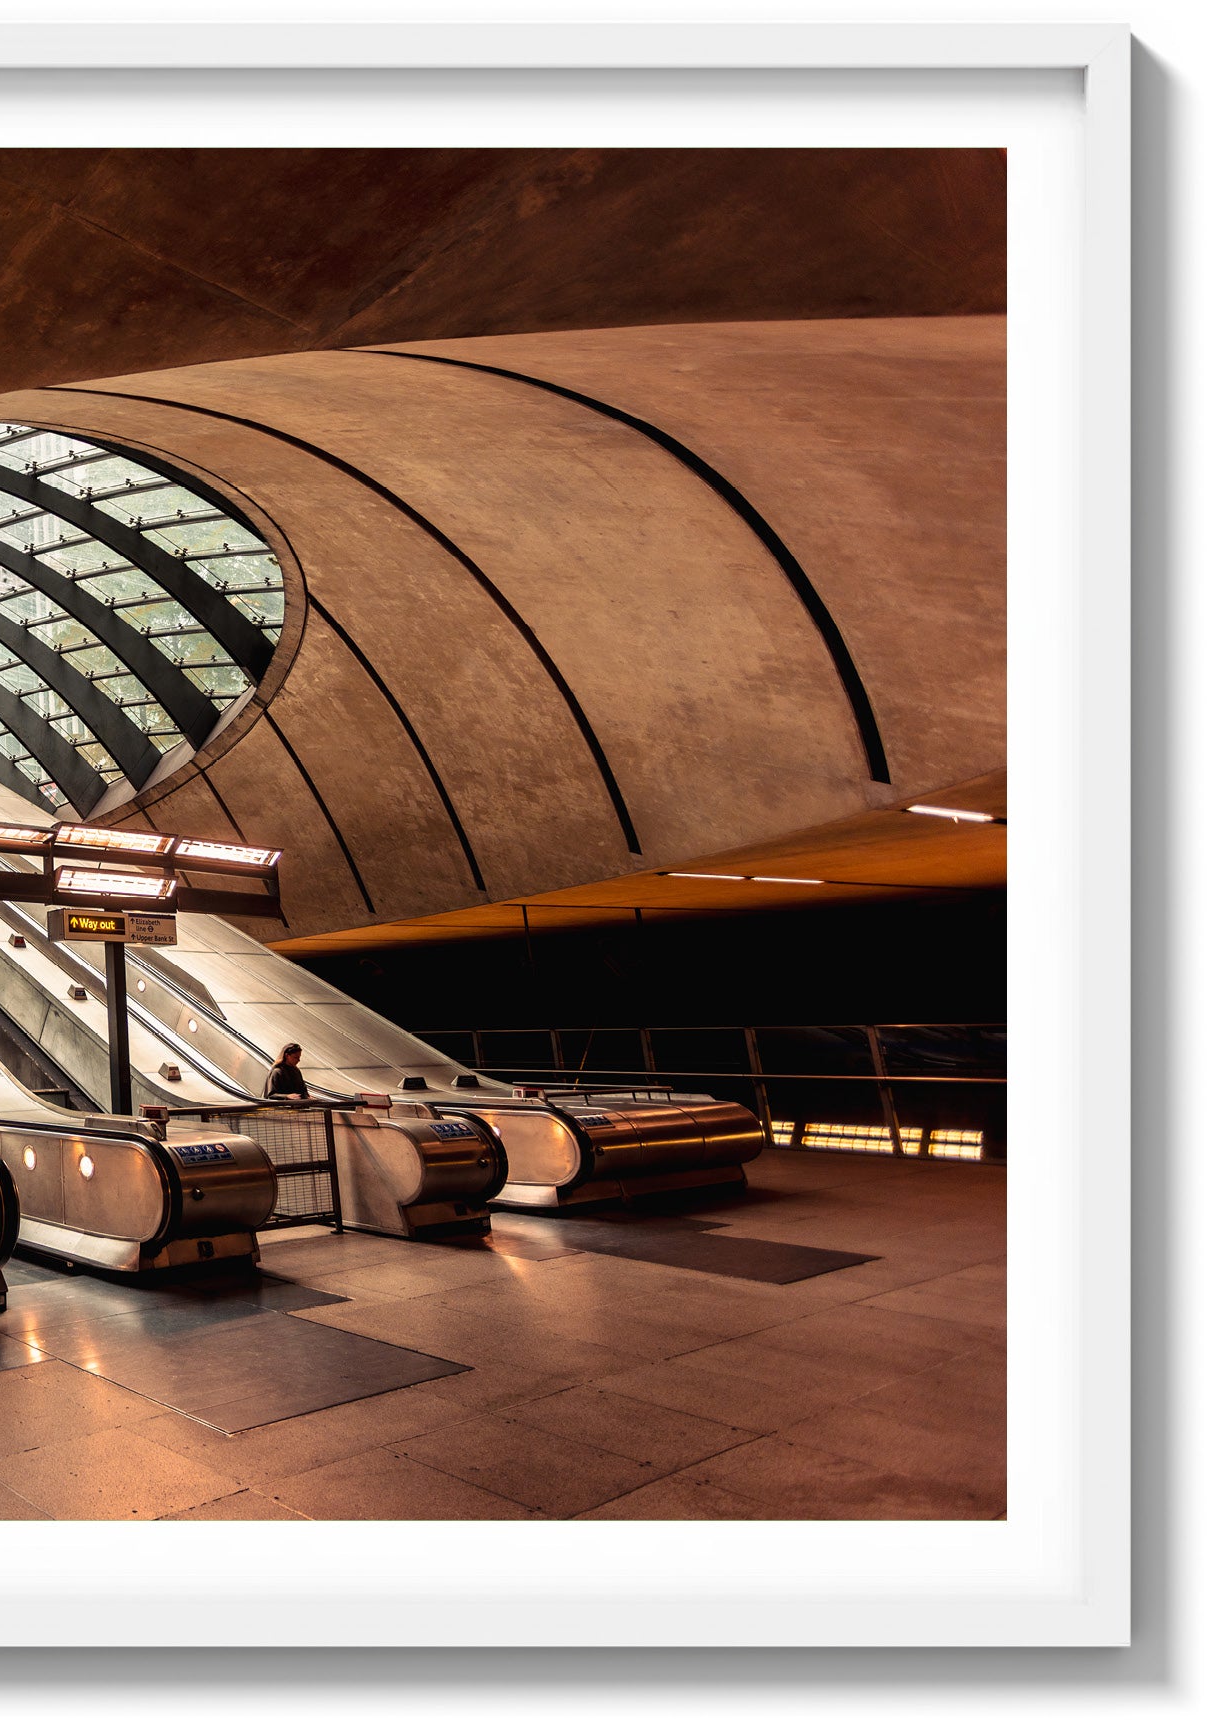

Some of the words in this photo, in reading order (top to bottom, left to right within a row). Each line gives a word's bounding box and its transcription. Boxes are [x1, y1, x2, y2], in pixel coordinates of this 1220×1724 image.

[79, 918, 98, 930] Way
[100, 920, 115, 930] out
[136, 918, 160, 926] Elizabeth
